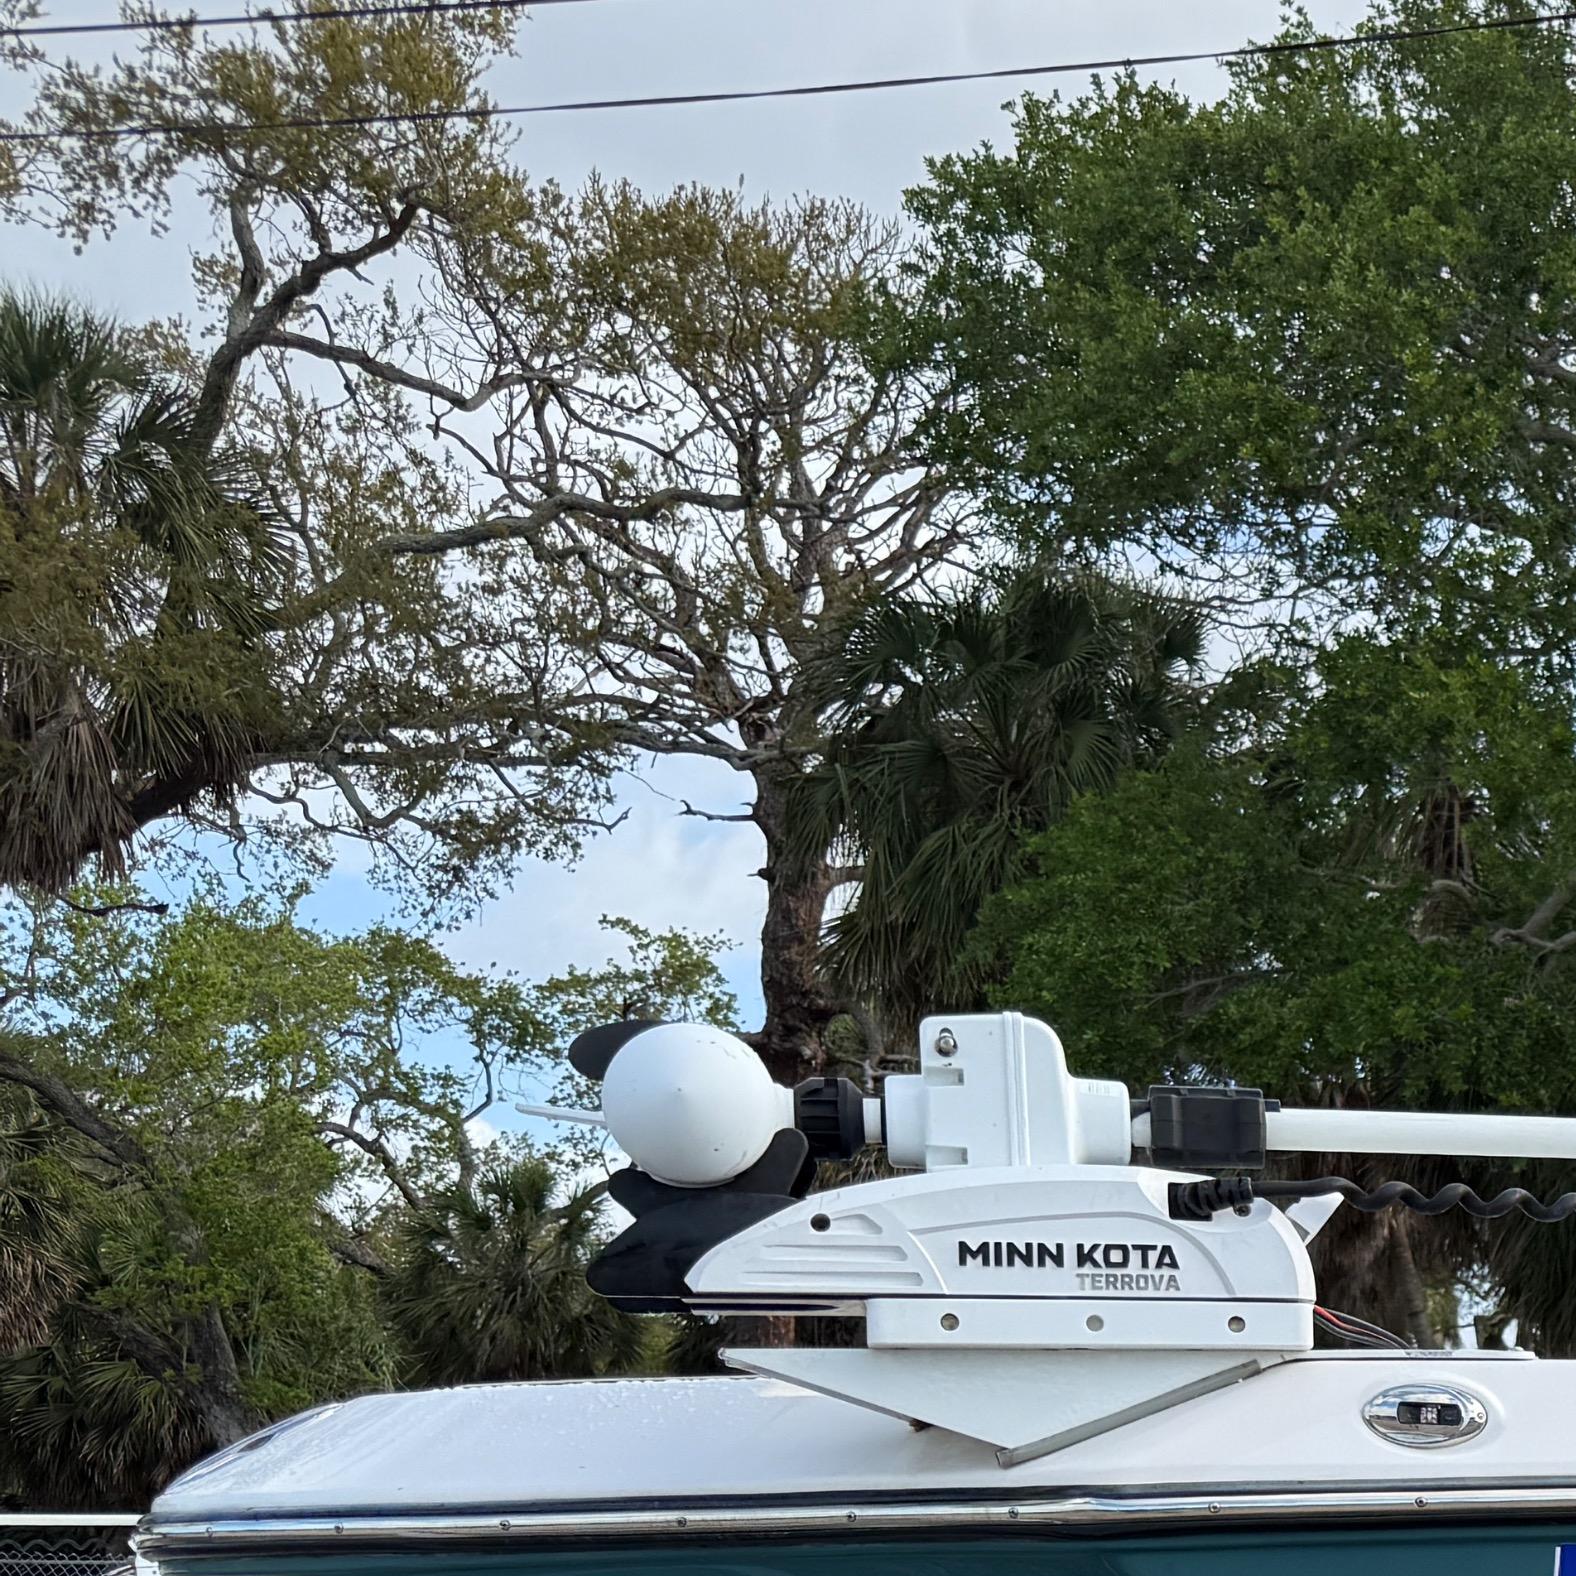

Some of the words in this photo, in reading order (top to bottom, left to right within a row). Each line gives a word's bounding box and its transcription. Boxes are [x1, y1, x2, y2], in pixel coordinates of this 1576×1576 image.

[958, 1240, 1065, 1268] MINN
[1076, 1243, 1181, 1270] KOTA
[1075, 1272, 1182, 1292] TERROVA
